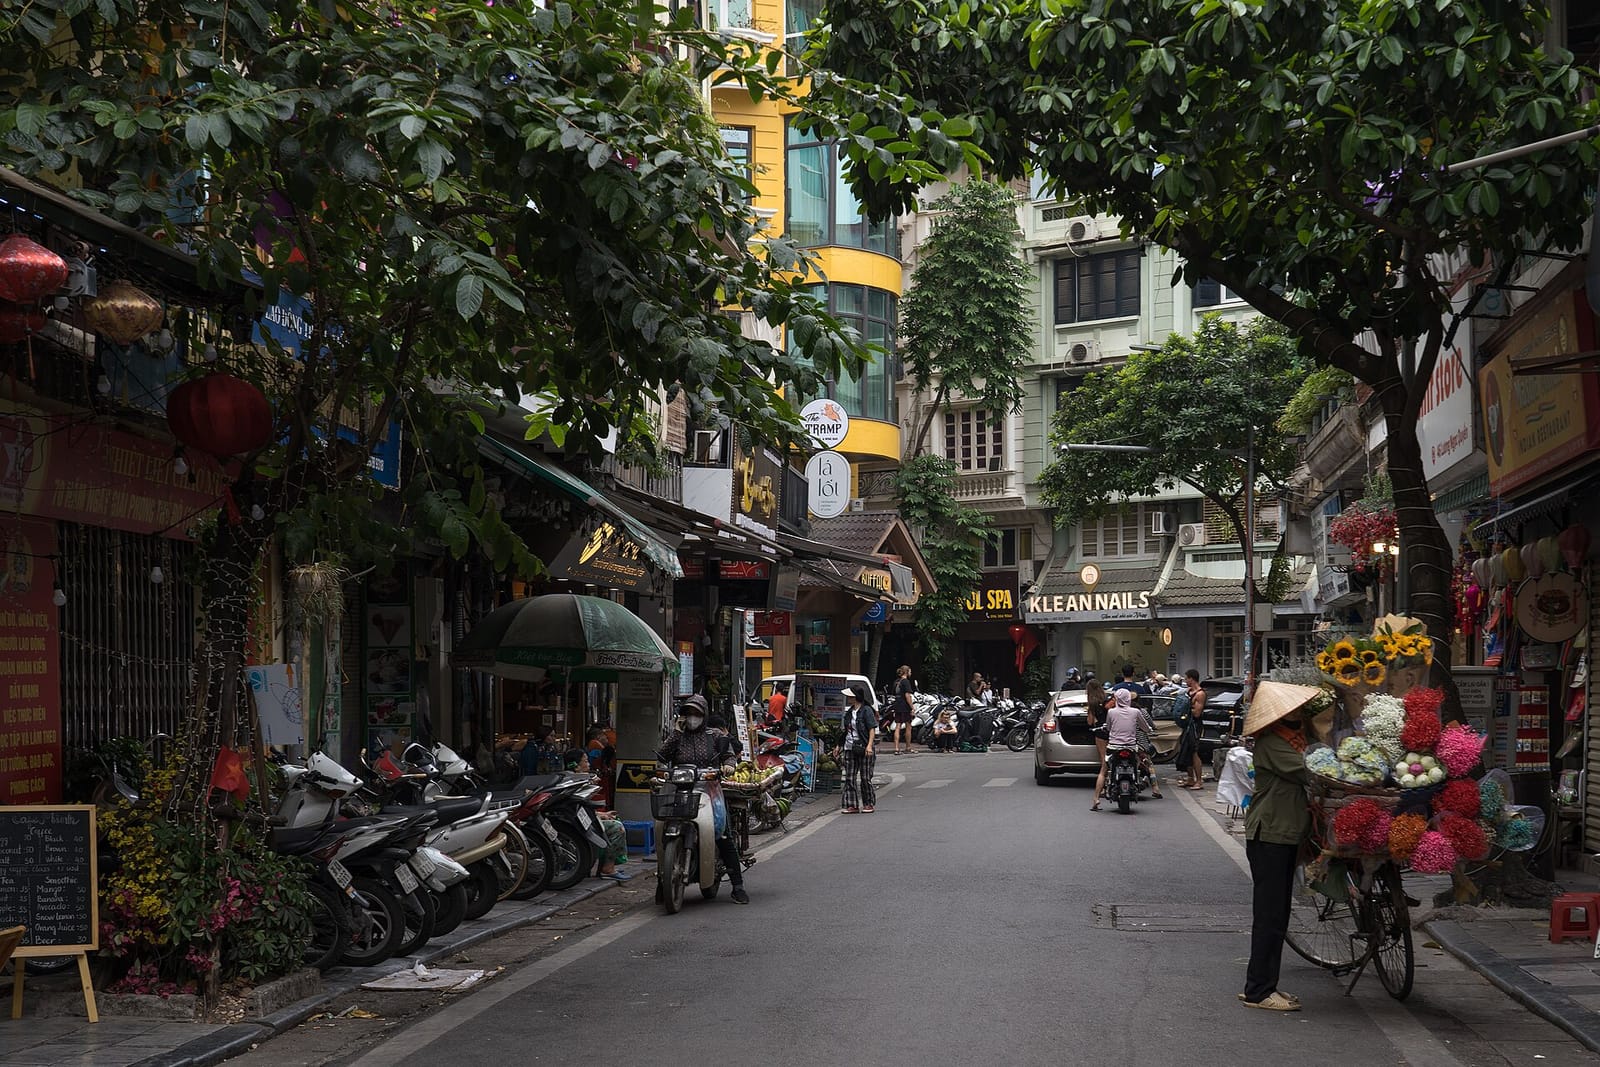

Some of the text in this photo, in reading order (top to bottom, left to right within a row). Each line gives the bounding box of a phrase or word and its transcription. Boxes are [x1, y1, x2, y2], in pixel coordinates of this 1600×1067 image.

[266, 305, 281, 325] LAO
[1436, 347, 1463, 407] store
[805, 424, 842, 436] TRAMP
[818, 457, 832, 476] lá
[818, 478, 839, 497] lốt
[987, 589, 1013, 610] SPA
[1031, 590, 1151, 613] KLEAN NAILS
